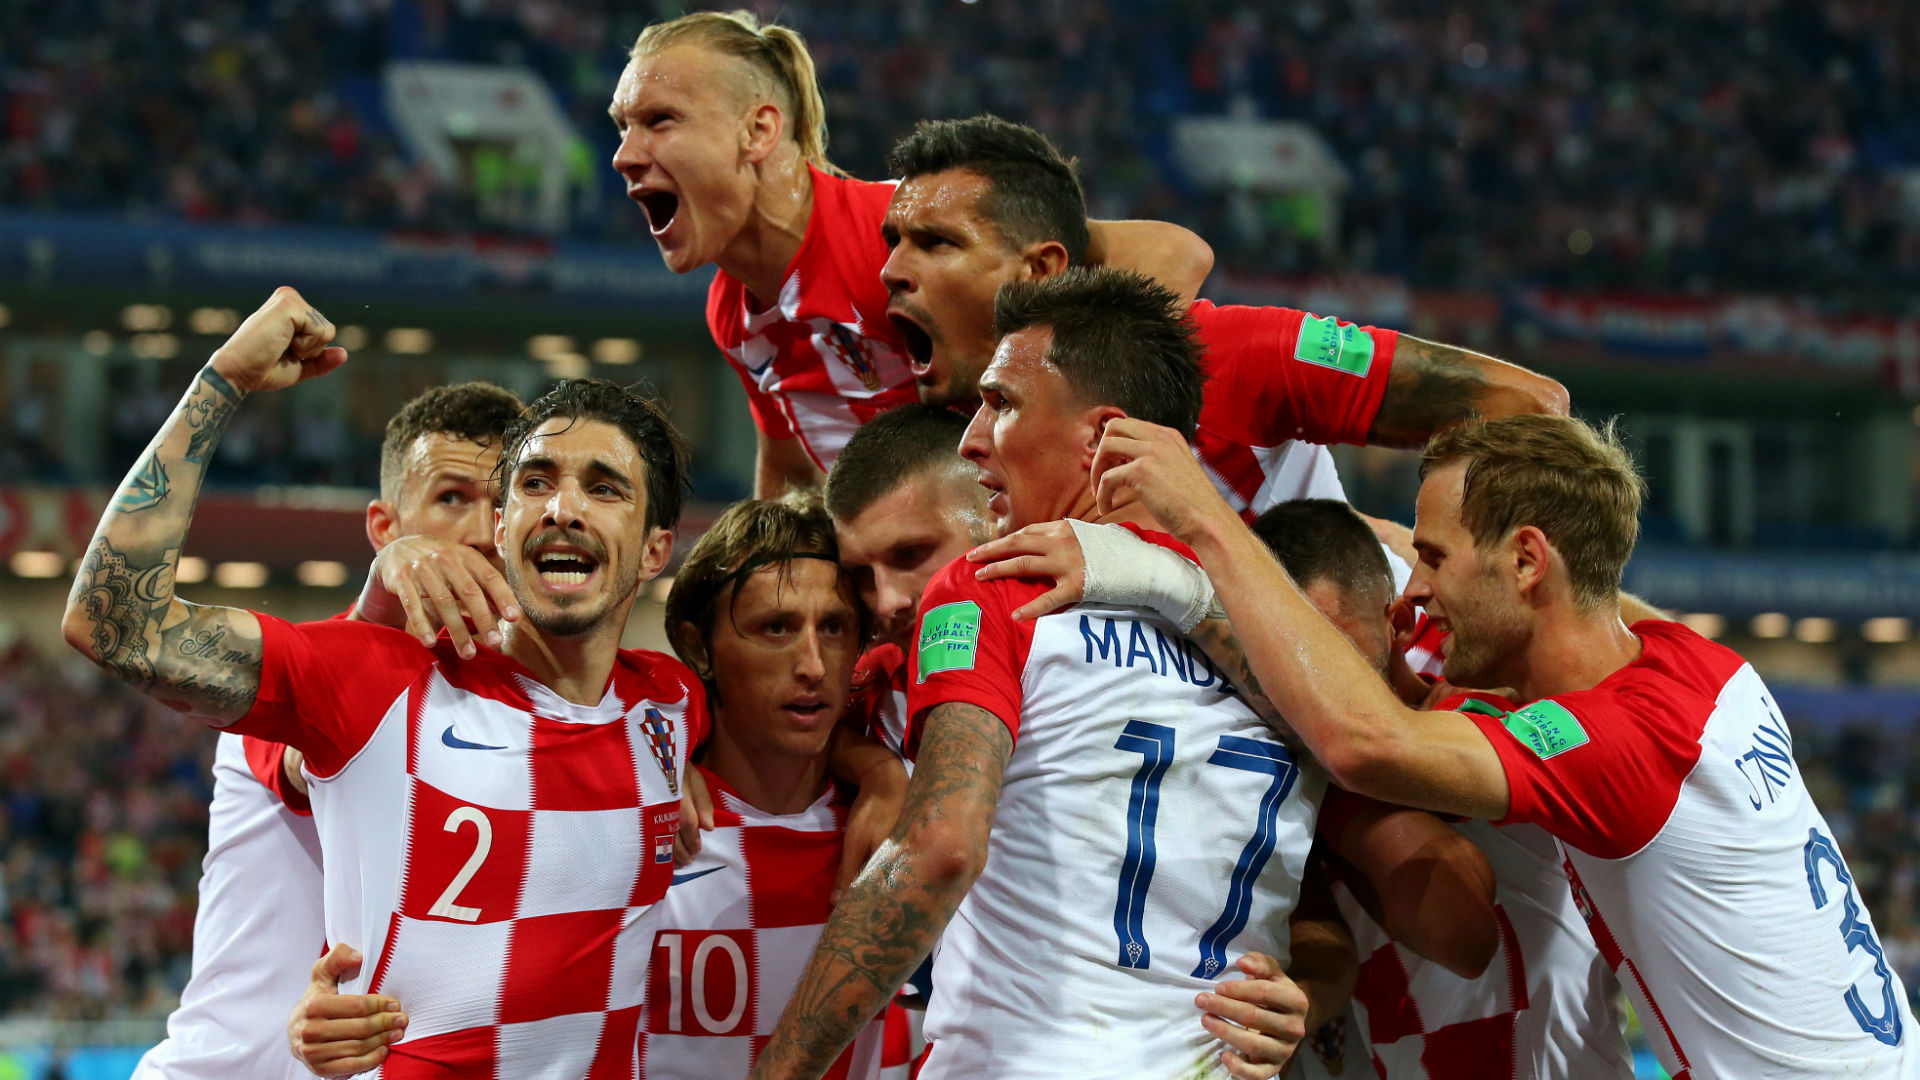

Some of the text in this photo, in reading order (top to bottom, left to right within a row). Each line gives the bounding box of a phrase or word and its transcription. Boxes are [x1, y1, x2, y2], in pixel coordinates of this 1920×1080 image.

[922, 622, 974, 639] LIVING
[922, 629, 972, 646] FOOTBALL
[947, 643, 970, 651] FIFA
[1524, 707, 1567, 746] LIVING
[1529, 732, 1544, 754] FIFA
[427, 806, 493, 922] 2
[1113, 719, 1299, 981] 17
[1804, 827, 1903, 1047] 3
[657, 933, 749, 1034] 10
